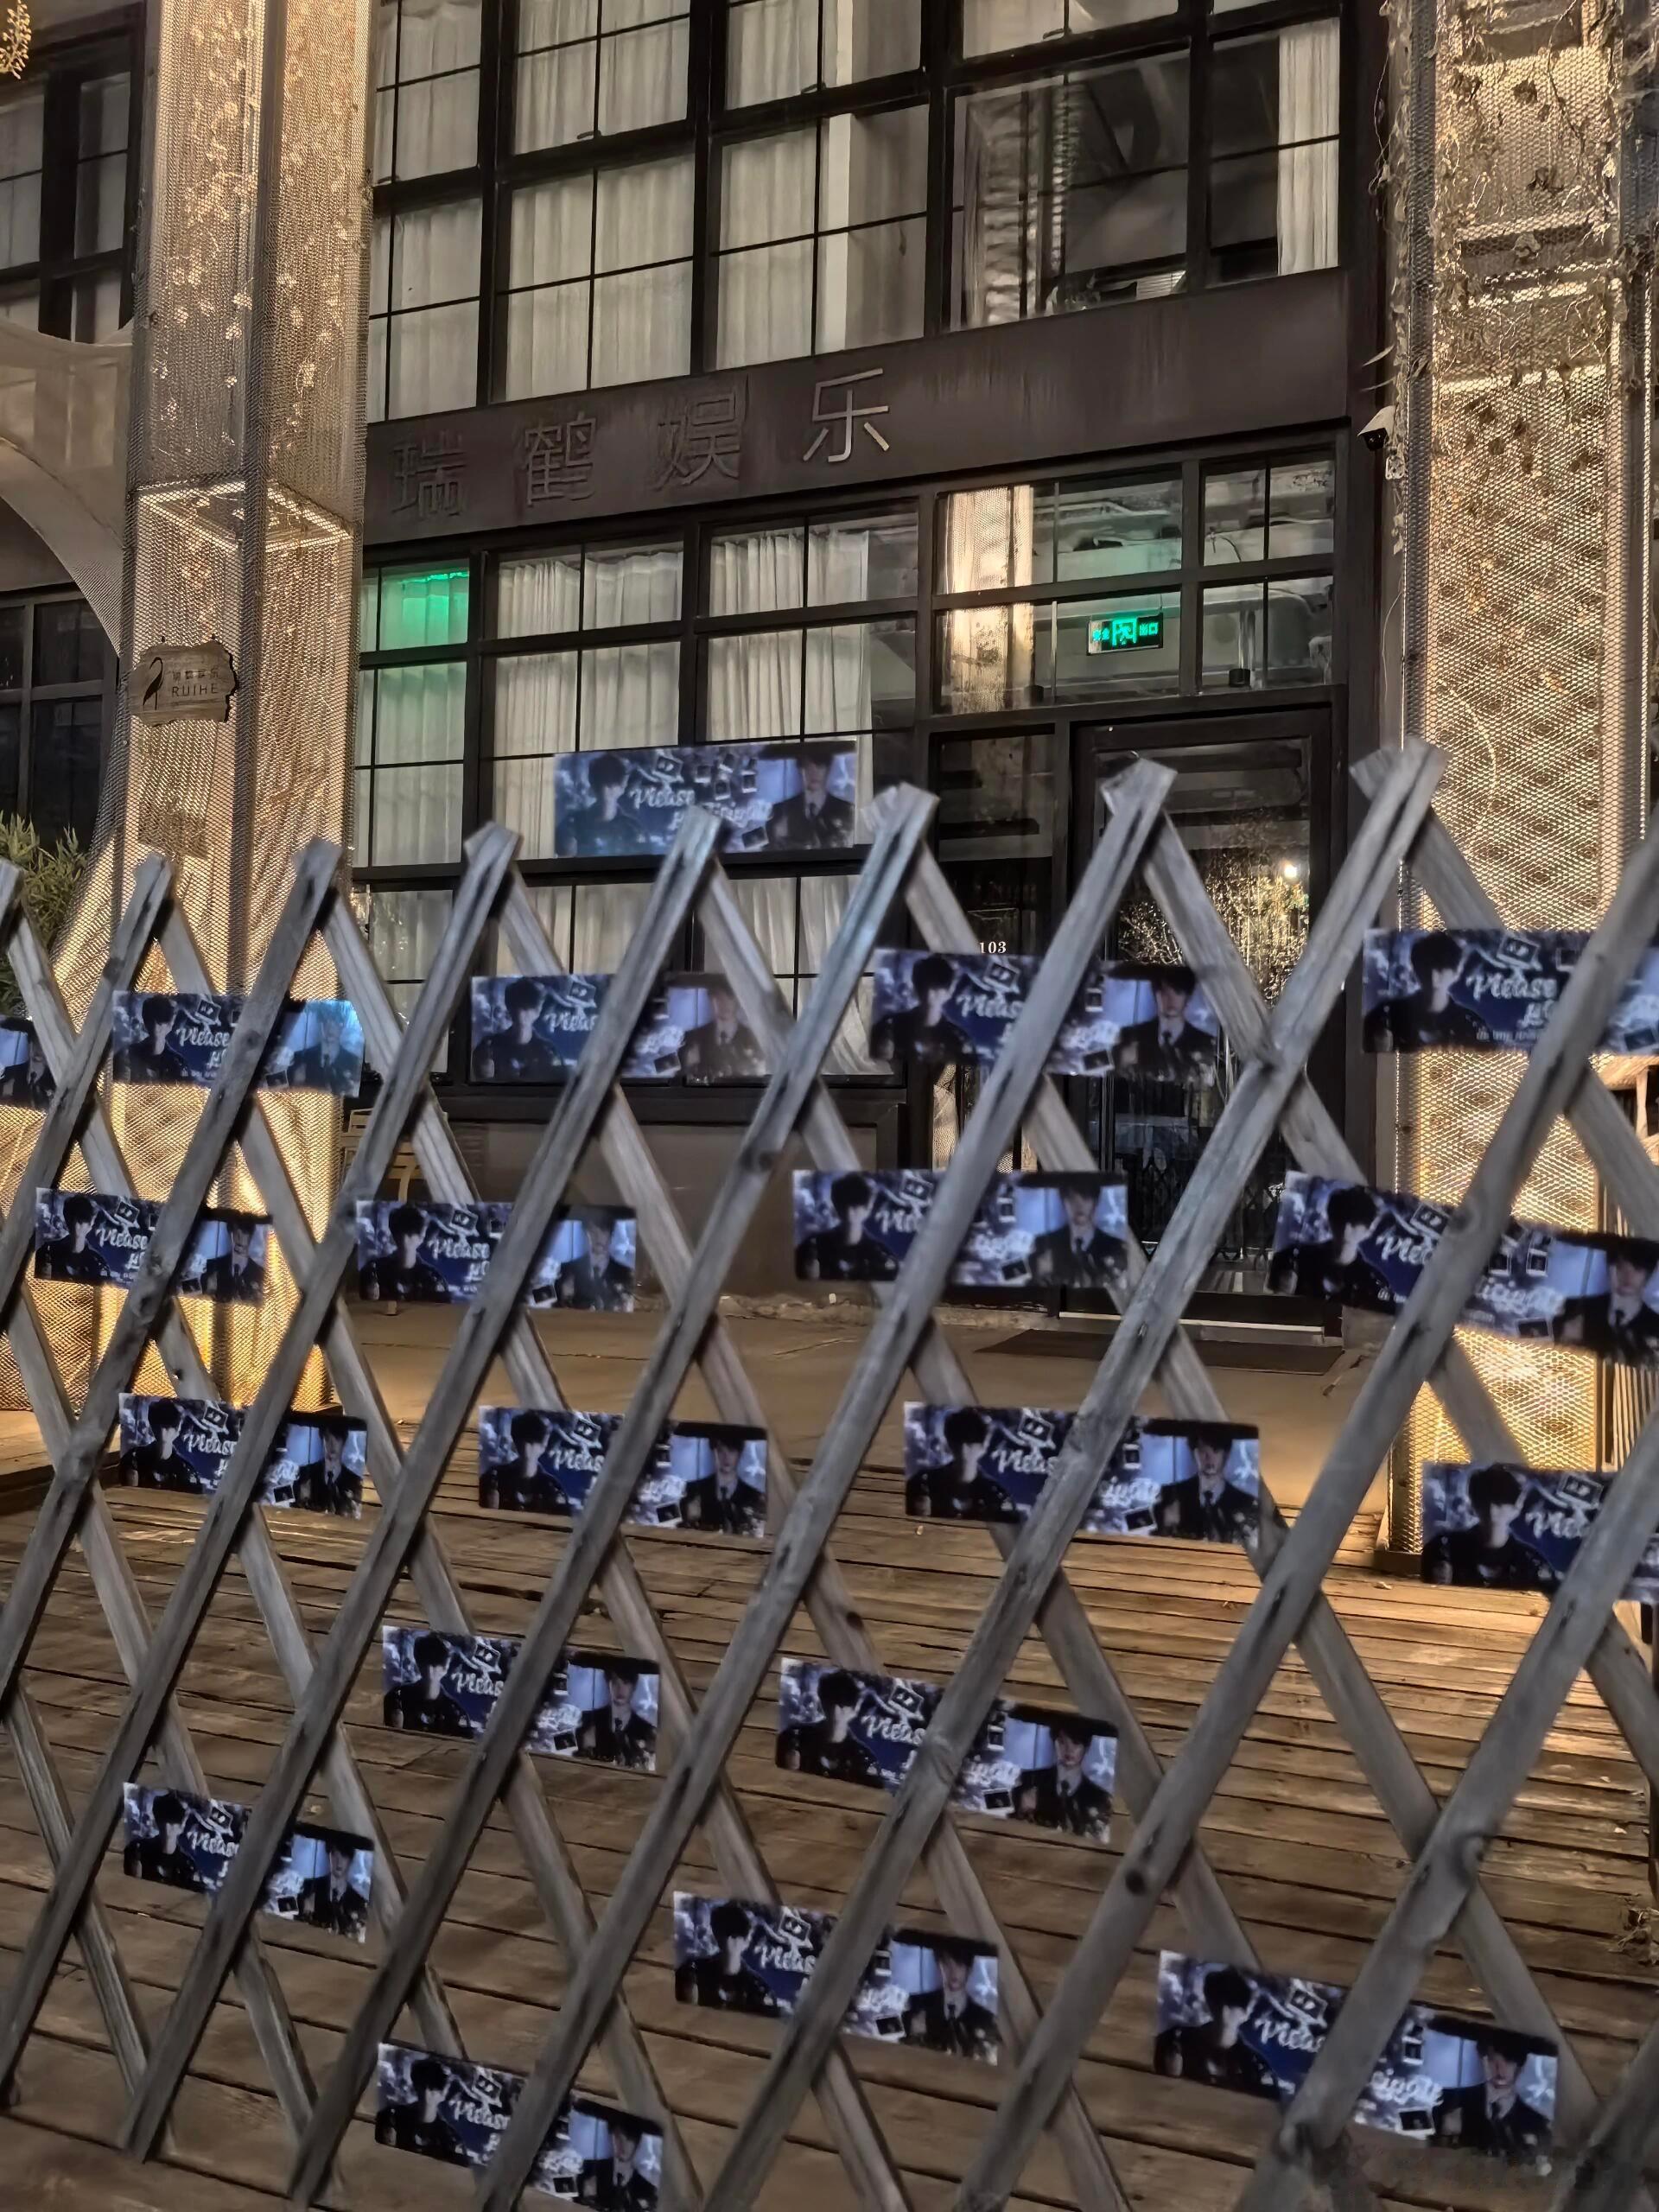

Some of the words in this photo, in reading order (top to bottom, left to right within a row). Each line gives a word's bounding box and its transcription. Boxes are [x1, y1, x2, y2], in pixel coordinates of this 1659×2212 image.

[391, 366, 890, 518] 瑞鹤娱乐
[172, 683, 219, 697] RUIHE
[980, 941, 1007, 954] 103
